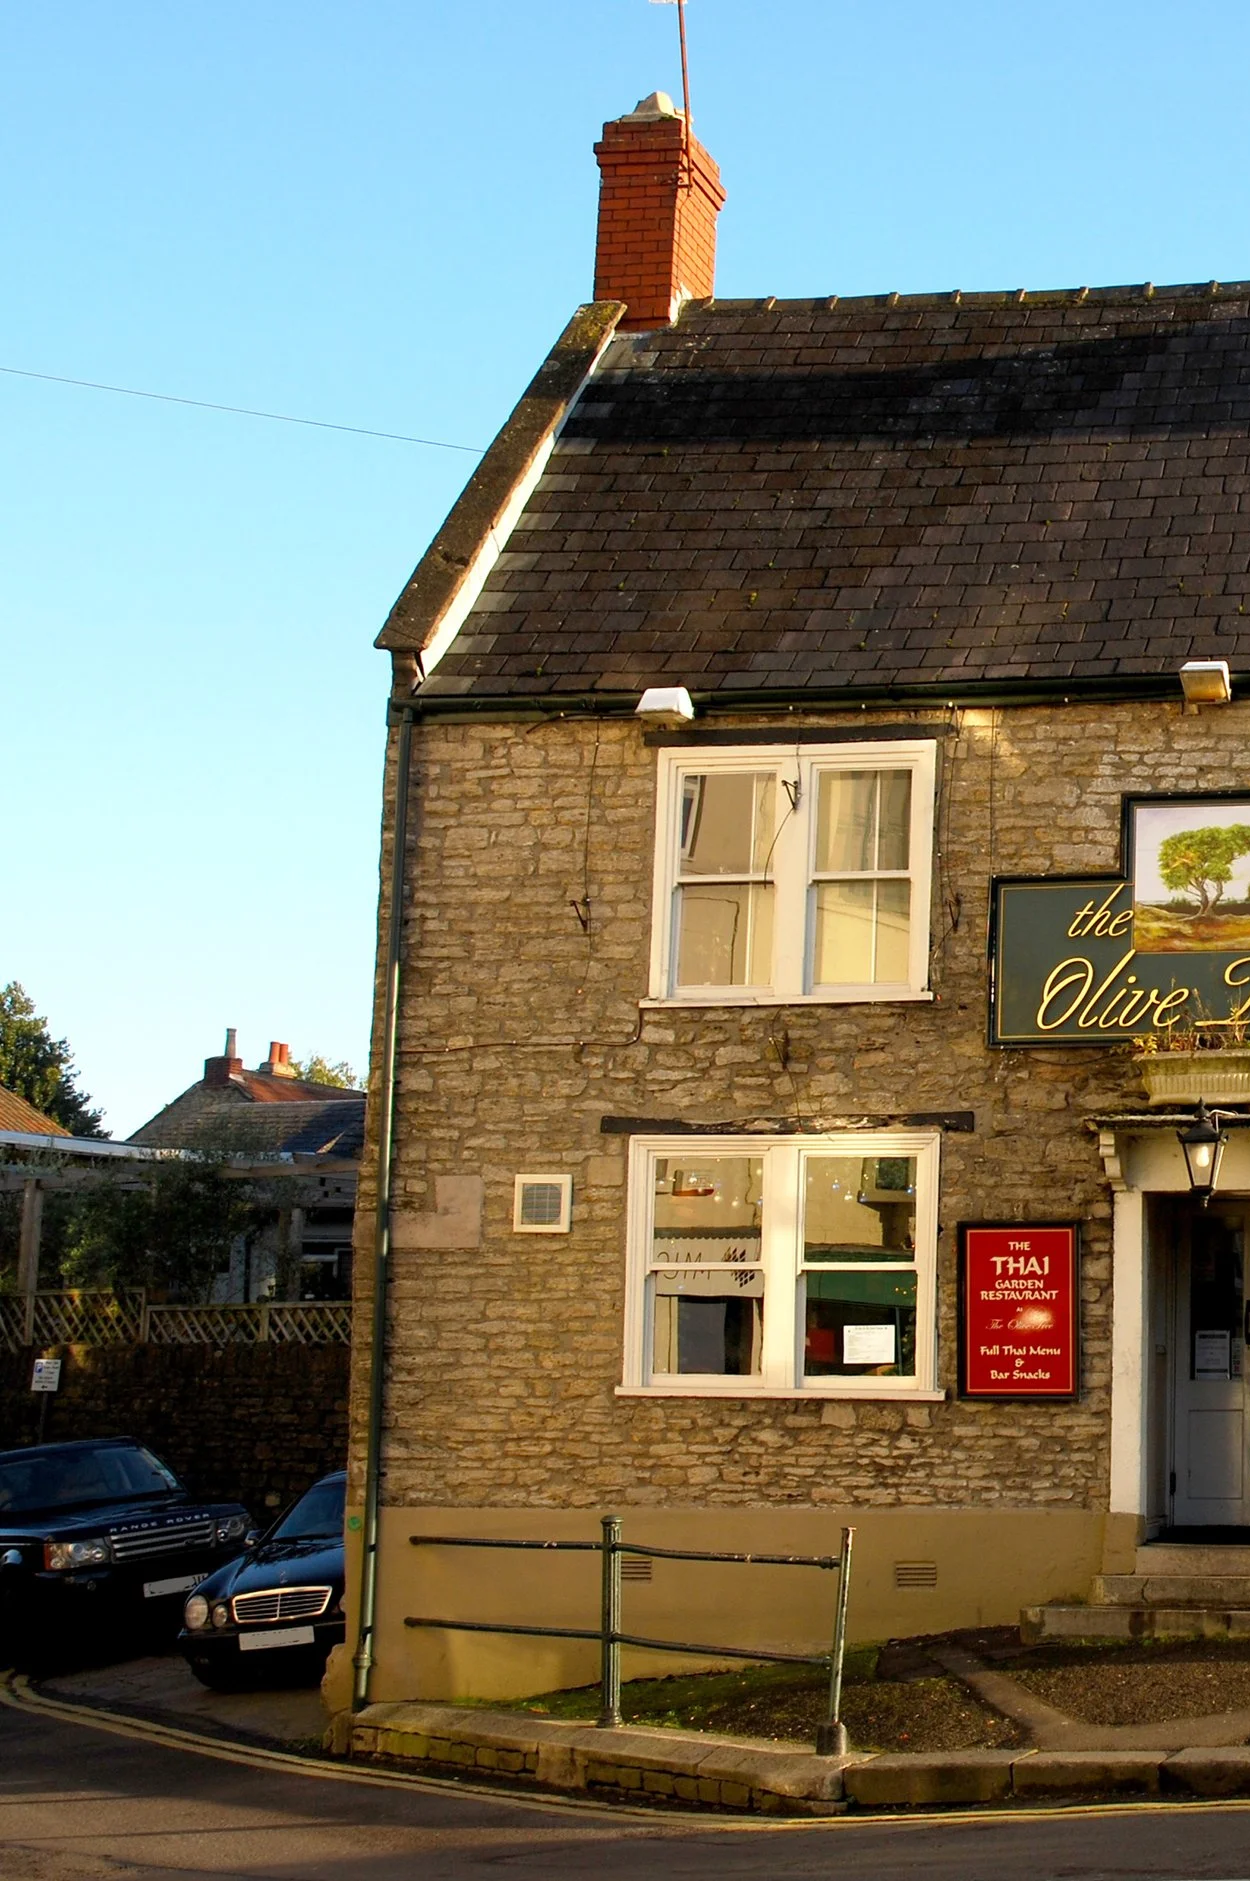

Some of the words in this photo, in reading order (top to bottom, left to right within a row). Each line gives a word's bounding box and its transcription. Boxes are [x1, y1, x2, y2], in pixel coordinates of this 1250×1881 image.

[1067, 883, 1134, 938] the
[1035, 948, 1190, 1030] Olive
[1008, 1241, 1031, 1251] THE
[990, 1256, 1049, 1276] THAI
[995, 1279, 1044, 1289] GARDEN
[980, 1290, 1059, 1301] RESTAURANT
[985, 1318, 1004, 1330] The
[980, 1345, 999, 1356] Full
[1002, 1345, 1027, 1356] Thai
[1029, 1346, 1061, 1356] Menu
[1014, 1358, 1025, 1368] &
[990, 1369, 1010, 1380] Bar
[1012, 1368, 1051, 1380] Snacks
[109, 1521, 158, 1533] RANGE
[166, 1513, 210, 1524] ROVER
